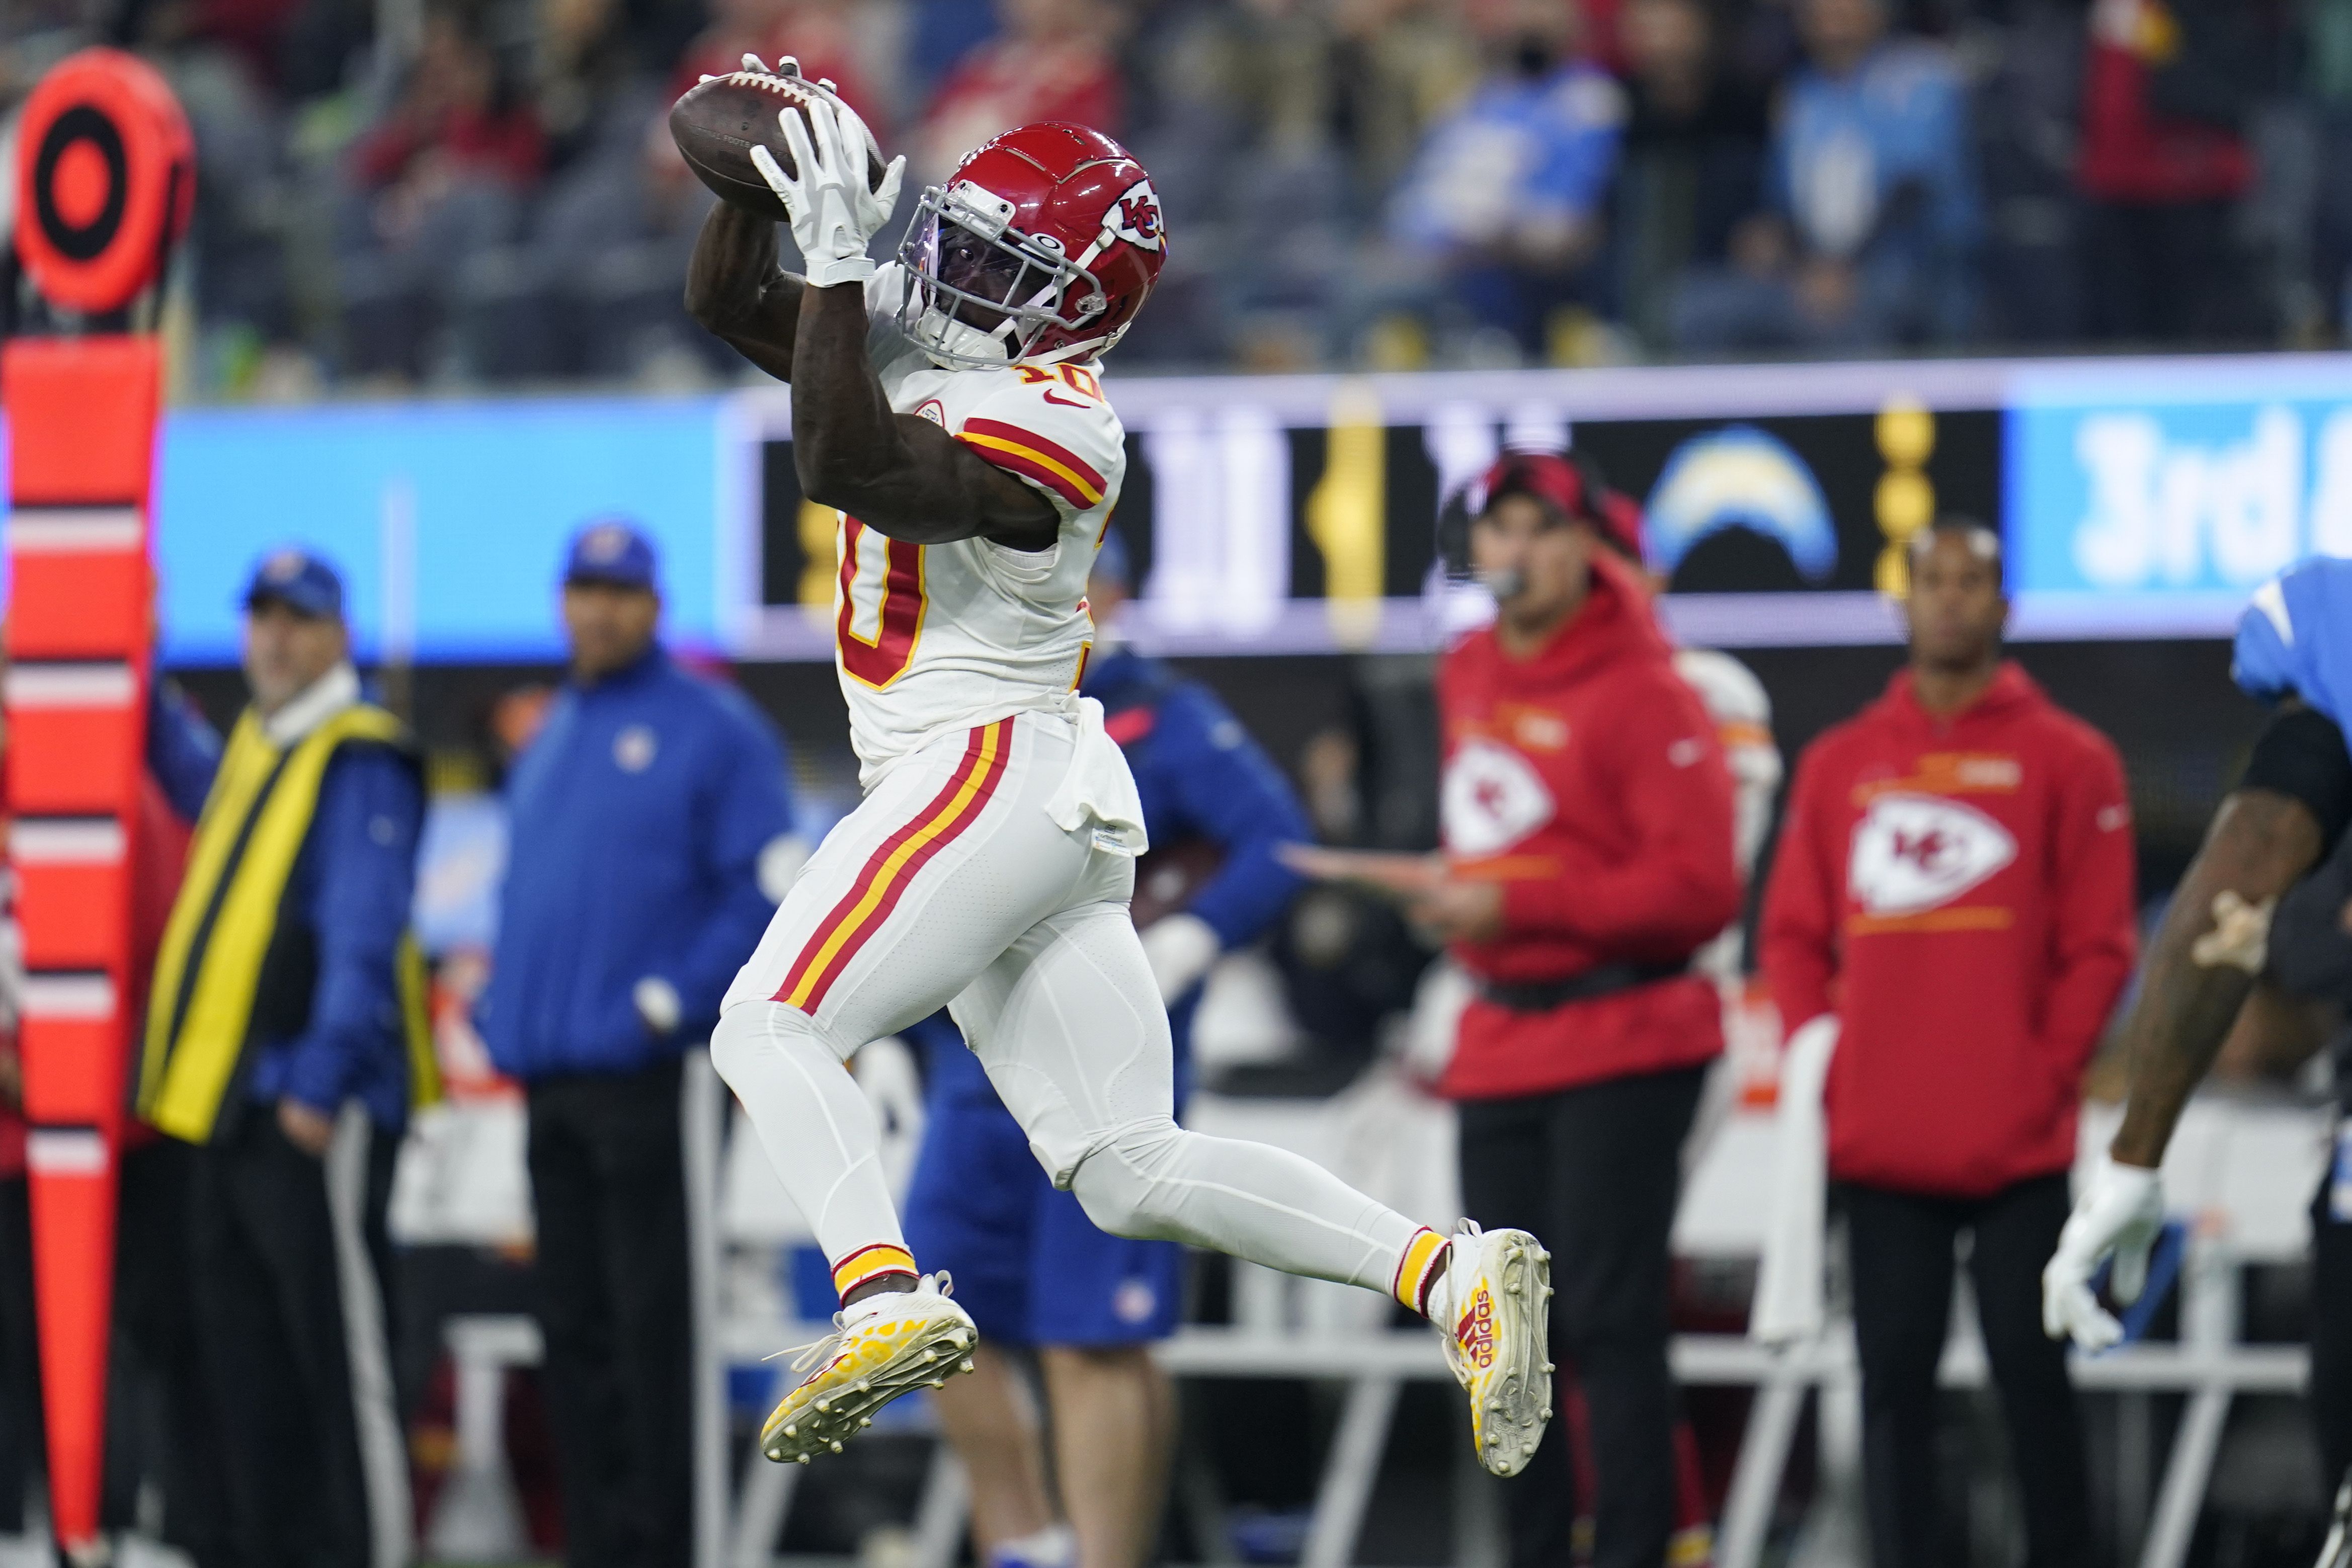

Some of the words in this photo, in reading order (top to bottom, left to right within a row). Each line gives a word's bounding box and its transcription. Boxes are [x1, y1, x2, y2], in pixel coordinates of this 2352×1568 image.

[1118, 195, 1160, 239] KC
[1012, 362, 1105, 404] 10
[1477, 1290, 1493, 1368] adidas
